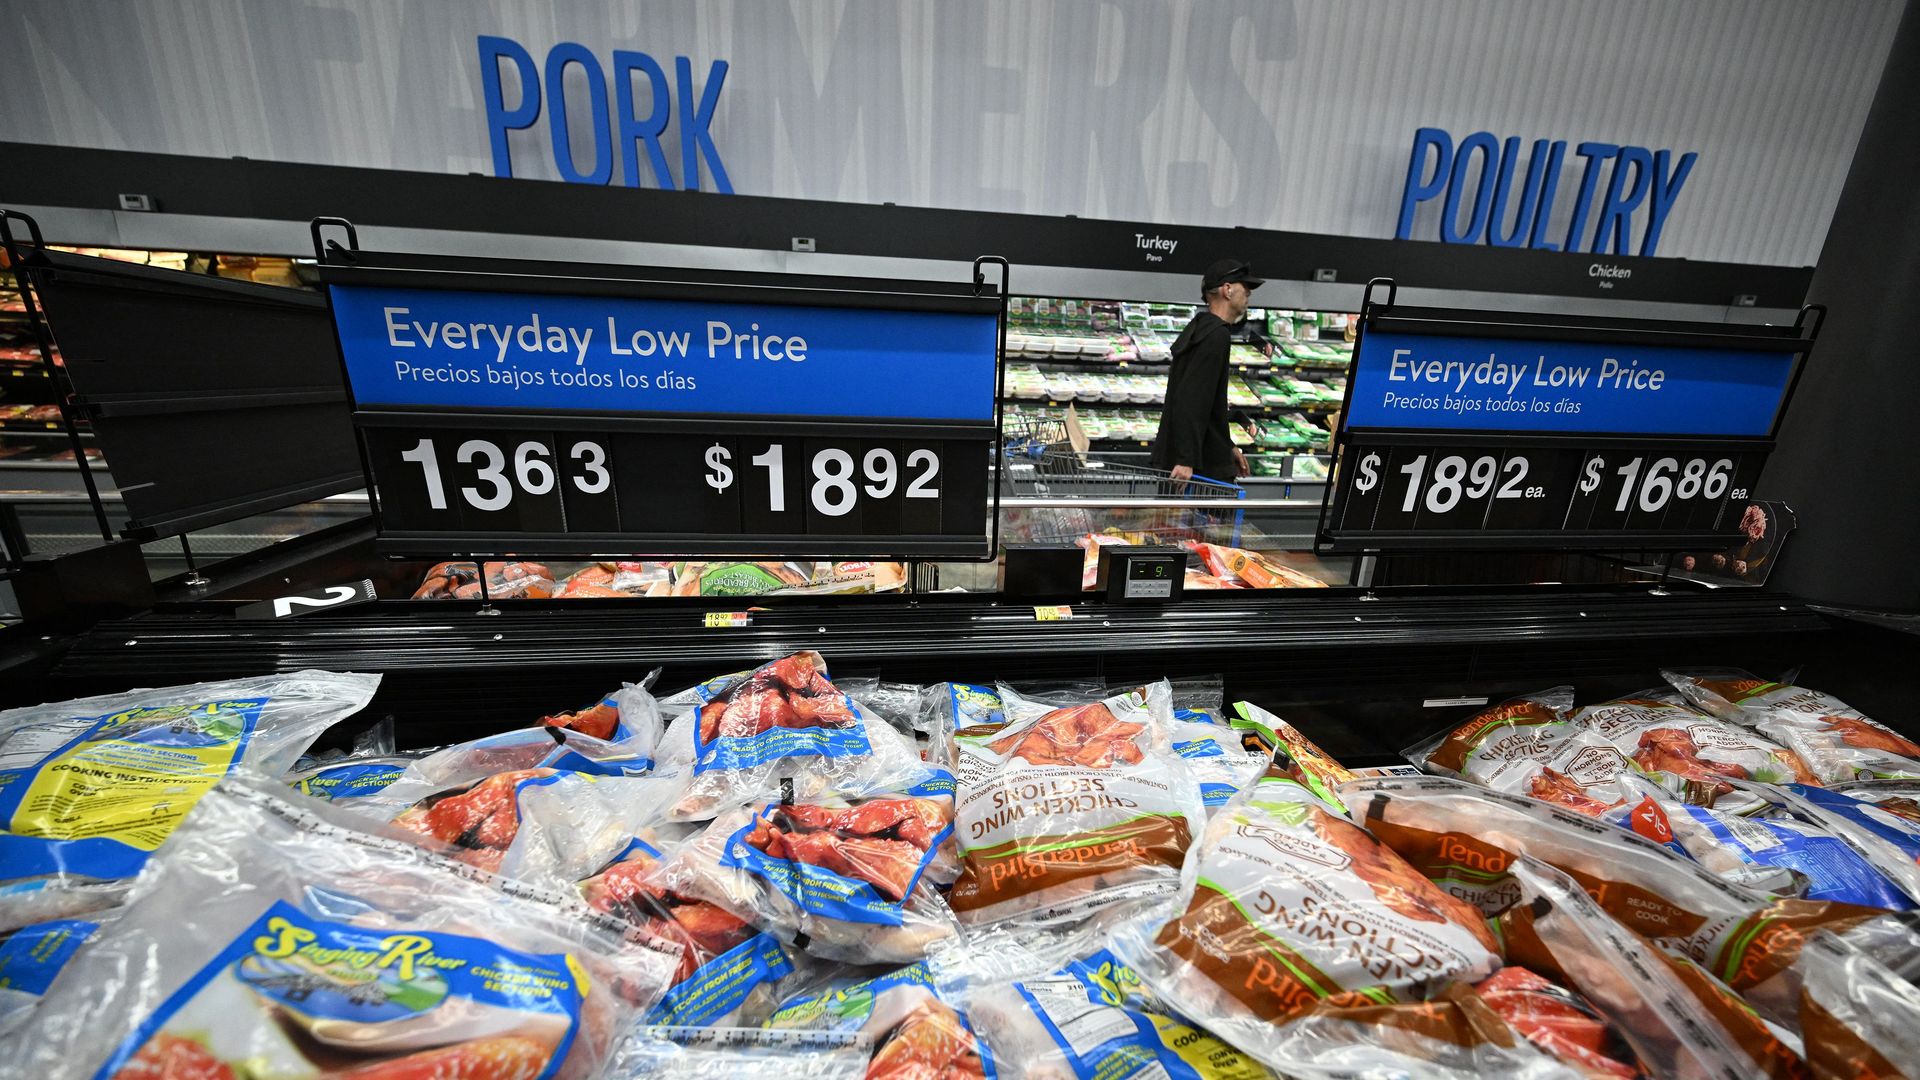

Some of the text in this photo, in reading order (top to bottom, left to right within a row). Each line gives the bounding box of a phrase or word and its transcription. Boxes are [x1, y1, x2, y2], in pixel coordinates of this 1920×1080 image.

[477, 35, 736, 195] PORK
[1395, 127, 1698, 257] POULTRY
[1135, 234, 1178, 255] Turkey
[1146, 253, 1163, 262] Pavo
[1588, 263, 1632, 278] Chicken
[383, 307, 808, 364] Everyday Low Price
[395, 361, 697, 391] Precios bajos todos los días
[1388, 349, 1665, 394] Everyday Low Price
[1383, 391, 1582, 415] Precios bajos todos los días
[273, 586, 356, 617] 2
[1479, 733, 1525, 761] CHICKE
[51, 764, 112, 779] COOKING
[1574, 752, 1612, 771] HORMONS
[993, 778, 1104, 810] SECTIONS
[971, 795, 1138, 840] CHICKEN WING
[990, 837, 1149, 892] TenderBird
[1626, 897, 1662, 911] READY
[1635, 910, 1669, 925] COOK
[253, 917, 468, 981] Singing River
[470, 966, 533, 985] CHICKEN
[1066, 983, 1084, 992] 210
[1213, 1058, 1239, 1069] OVEN
